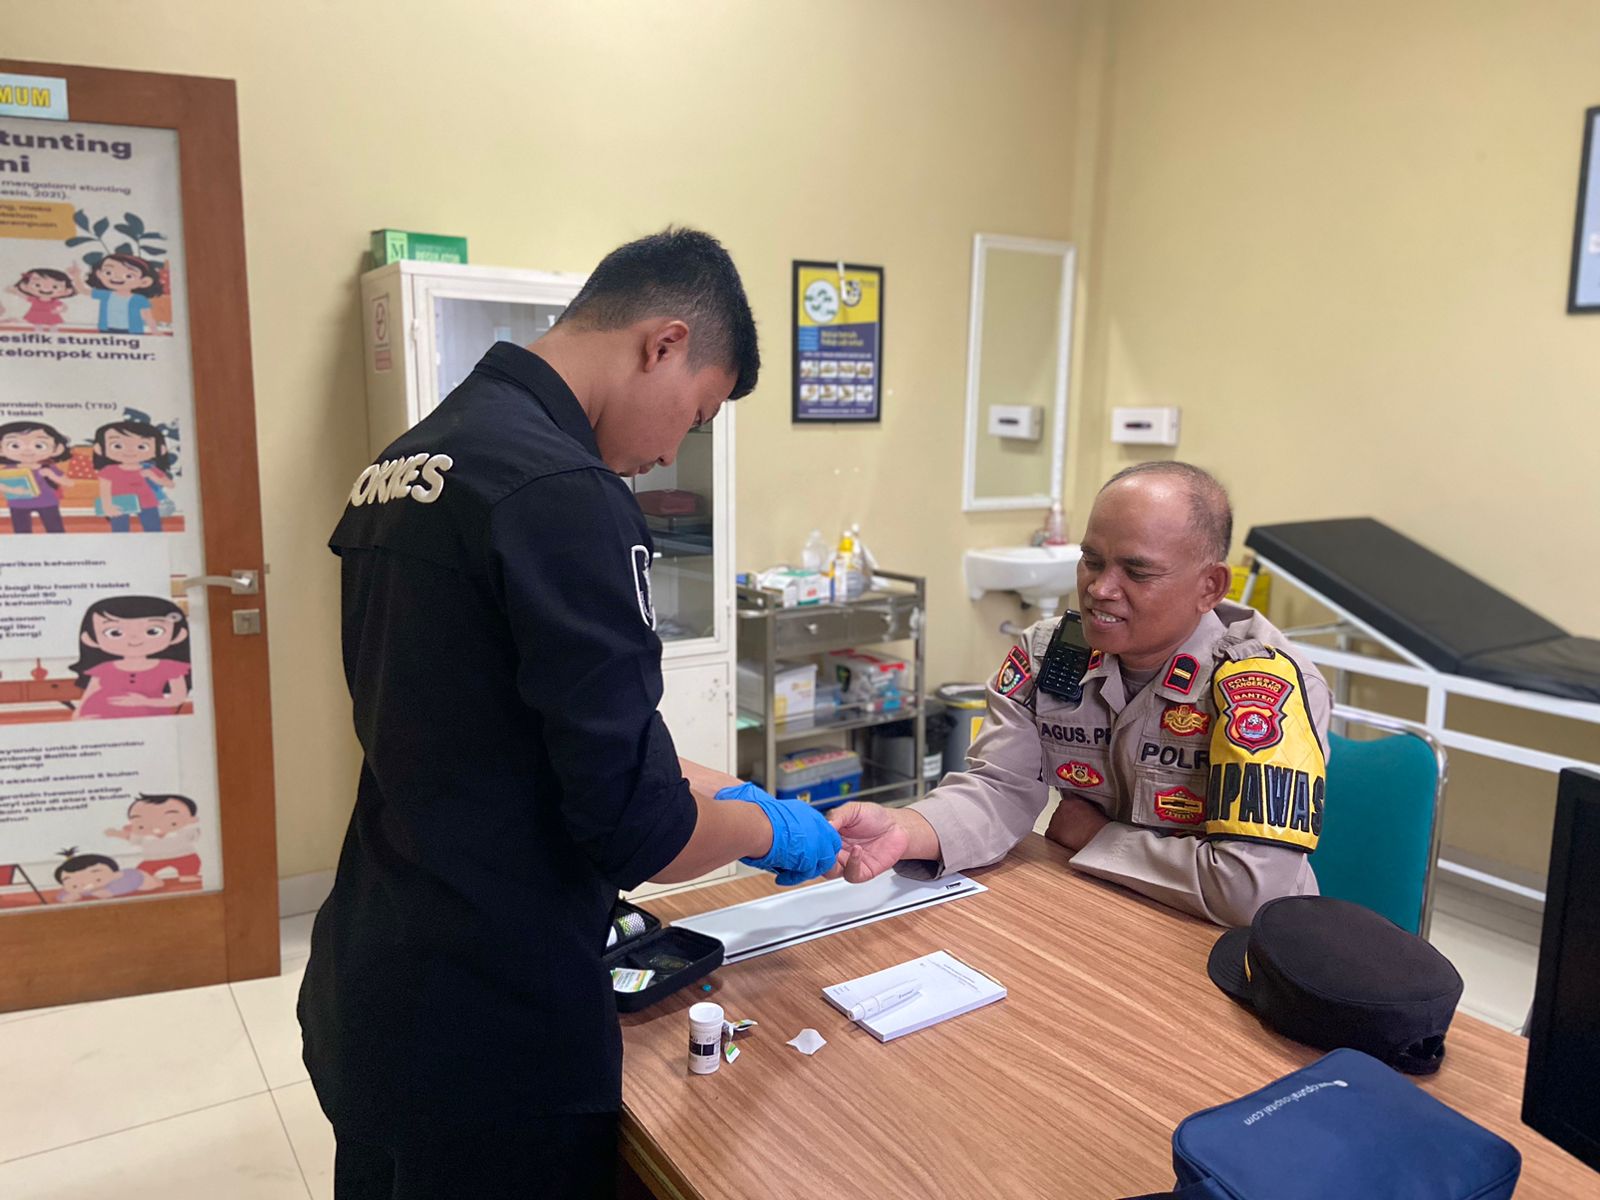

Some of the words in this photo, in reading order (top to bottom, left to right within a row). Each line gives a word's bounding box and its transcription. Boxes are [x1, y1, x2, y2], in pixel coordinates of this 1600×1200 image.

[0, 84, 51, 108] MUM
[79, 184, 131, 195] stunting
[57, 335, 141, 349] stunting
[0, 347, 93, 360] elompok
[97, 351, 156, 361] umur:
[348, 453, 454, 507] OKKES
[1230, 681, 1280, 693] TANGERANG
[1233, 692, 1275, 703] BANTEN
[1041, 722, 1091, 744] AGUS.
